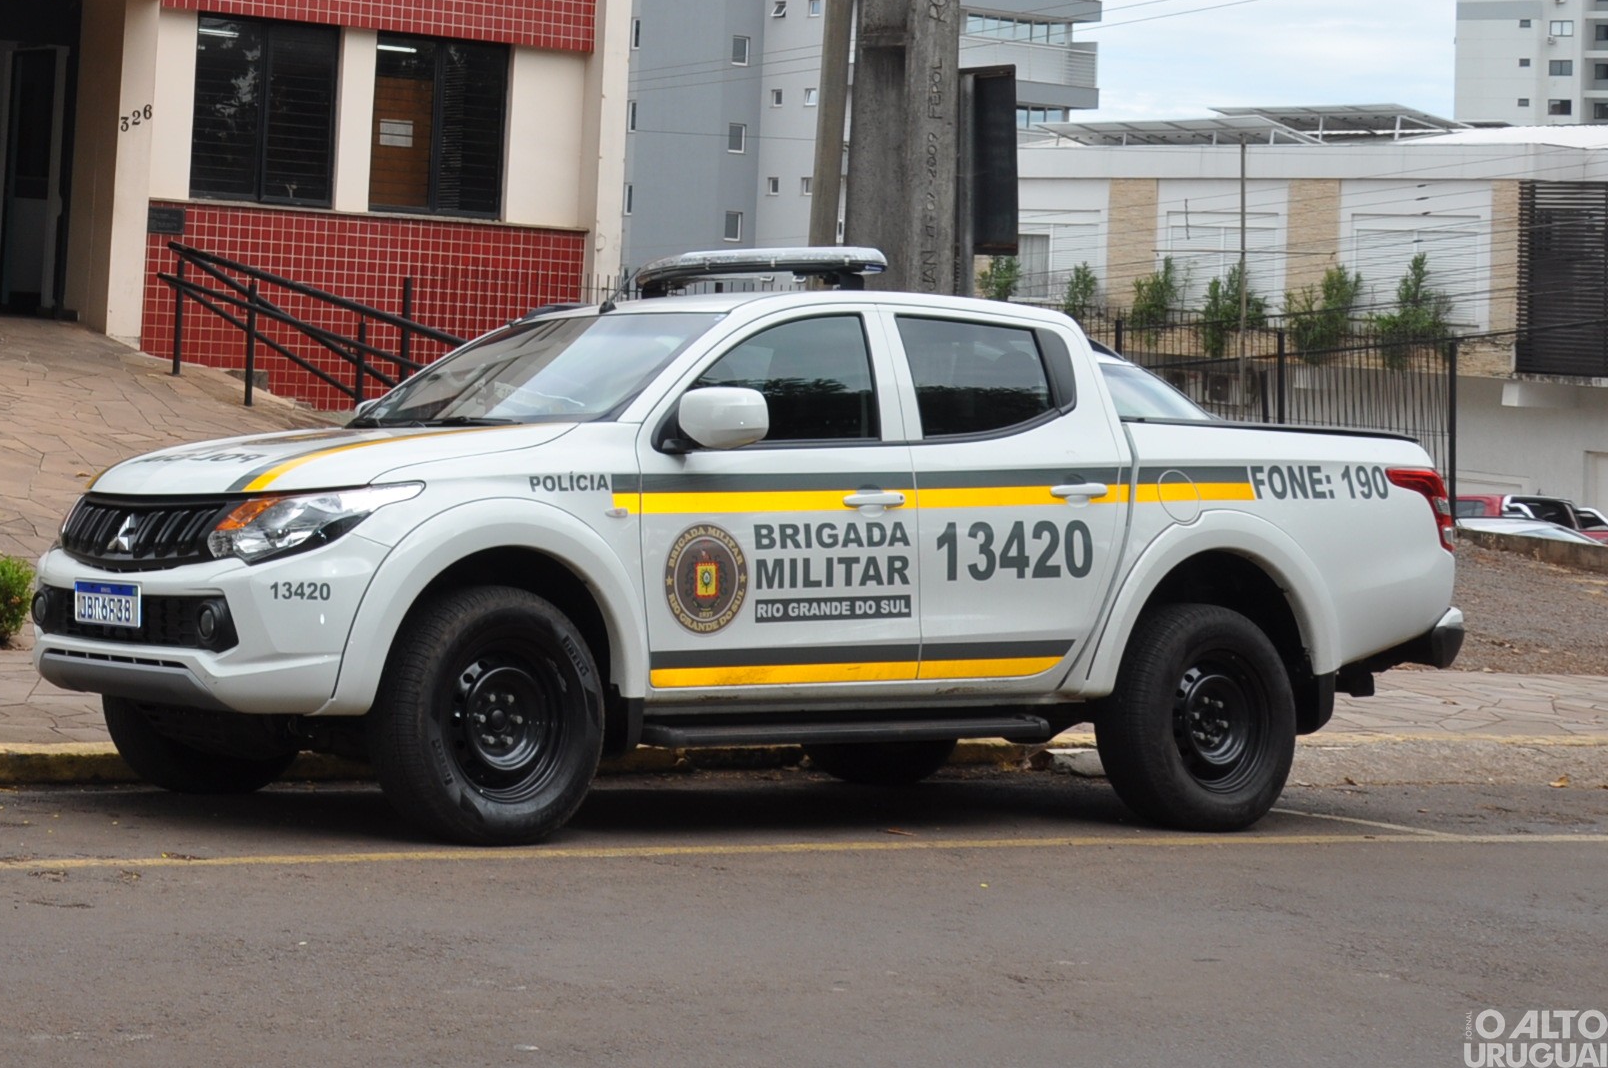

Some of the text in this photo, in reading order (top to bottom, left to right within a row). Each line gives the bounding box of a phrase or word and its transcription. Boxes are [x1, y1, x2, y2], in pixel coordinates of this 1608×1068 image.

[120, 104, 152, 132] 326
[529, 471, 609, 492] POLÍCIA
[1250, 465, 1389, 500] FONE: 190
[668, 526, 744, 568] BRIGADA MILITAR
[753, 521, 911, 550] BRIGADA
[936, 519, 1094, 581] 13420
[755, 555, 911, 590] MILITAR
[269, 581, 331, 601] 13420
[668, 588, 745, 631] RIO GRANDE DO SUL
[756, 598, 910, 618] RIO GRANDE DO SUL
